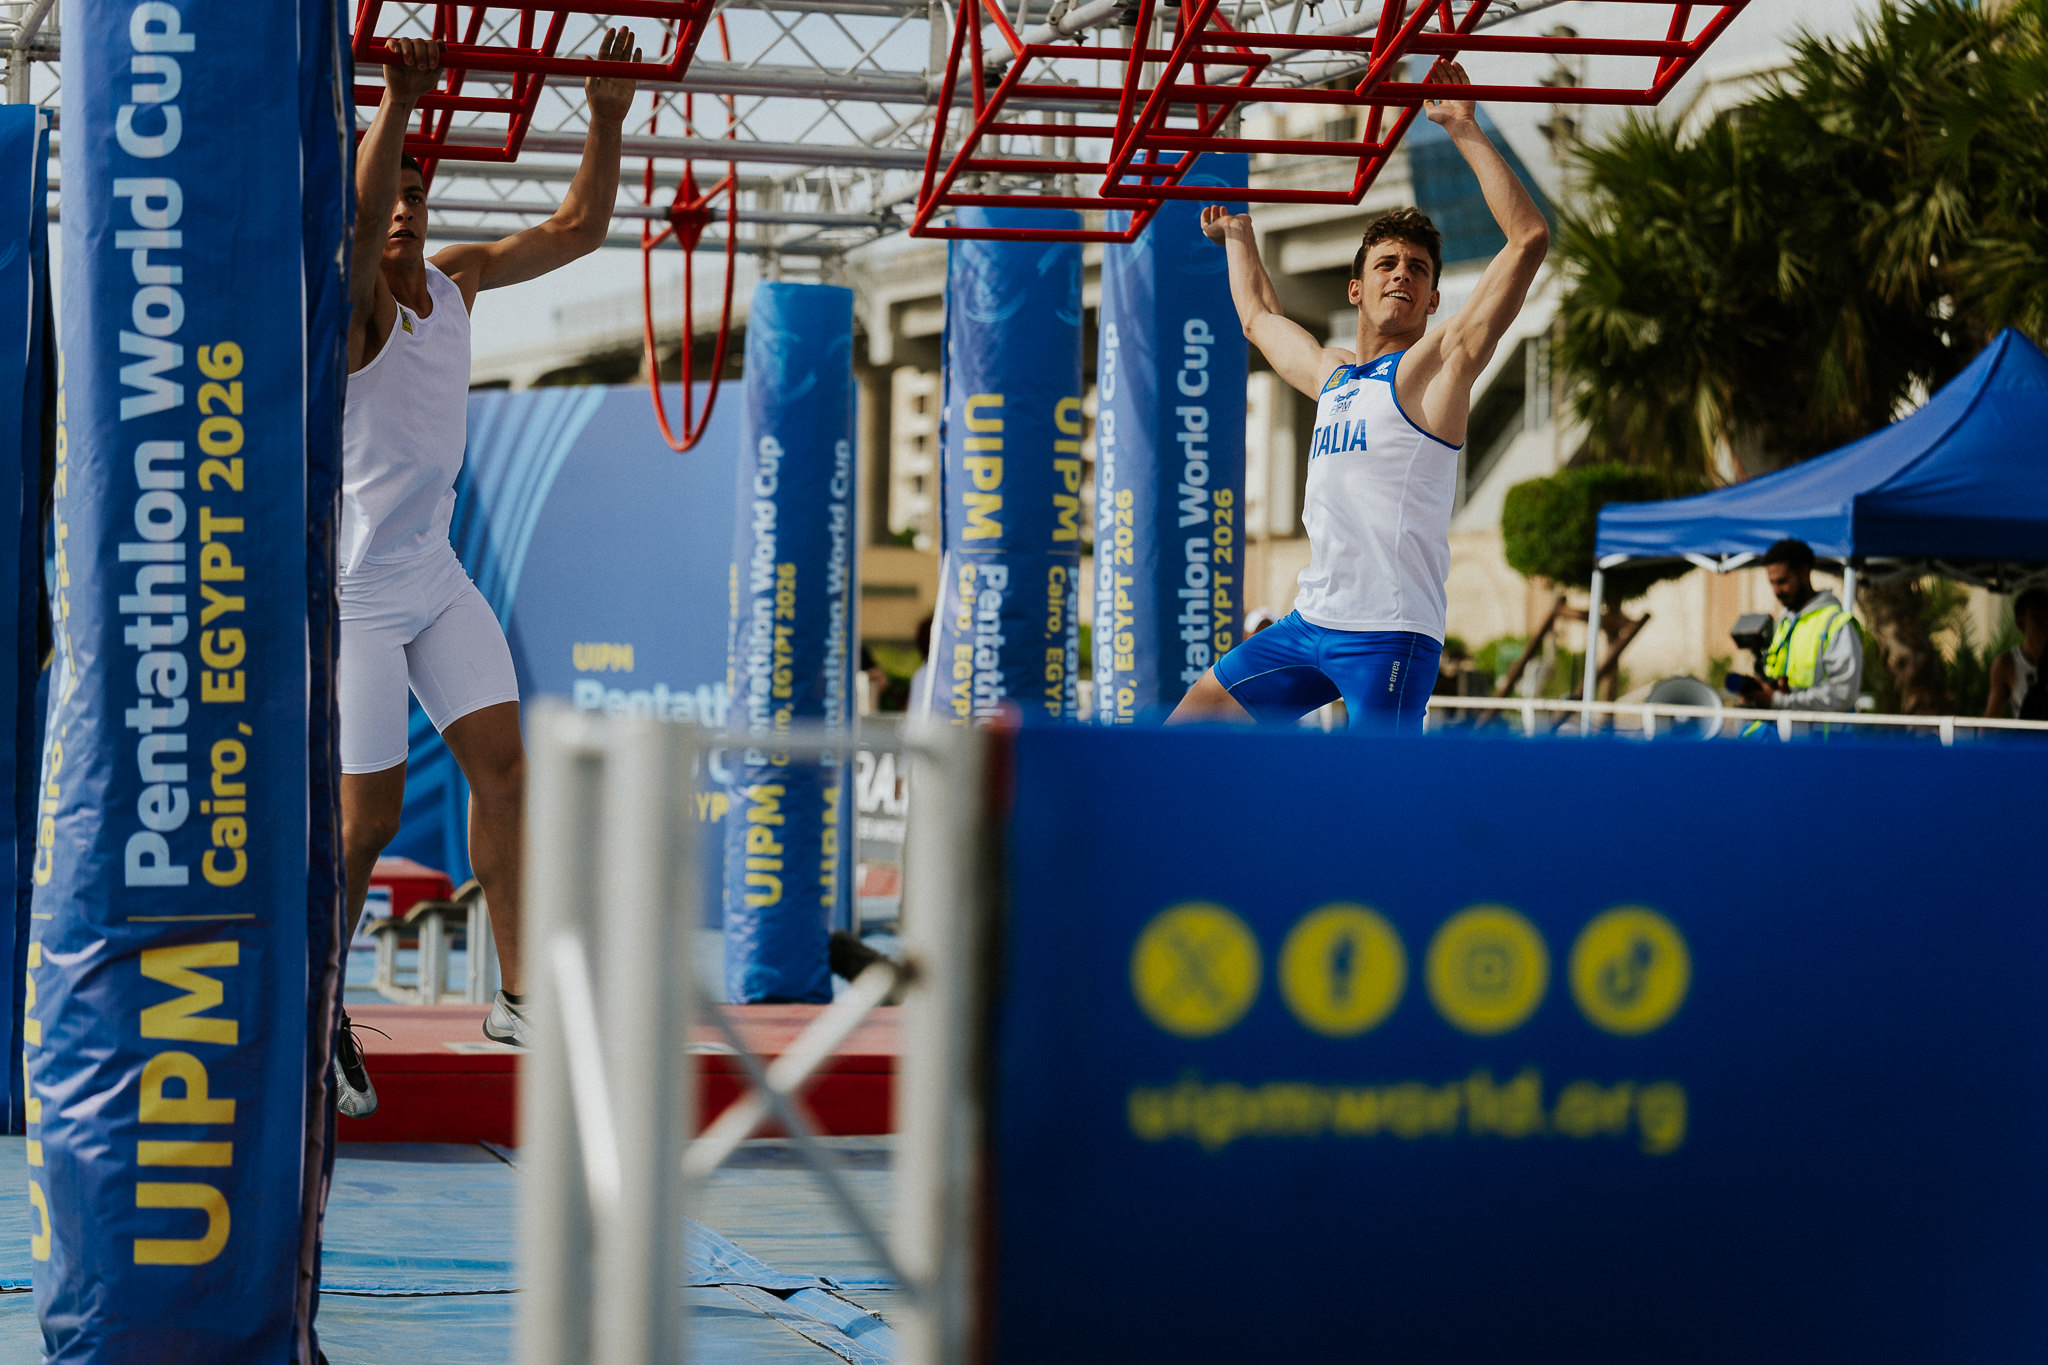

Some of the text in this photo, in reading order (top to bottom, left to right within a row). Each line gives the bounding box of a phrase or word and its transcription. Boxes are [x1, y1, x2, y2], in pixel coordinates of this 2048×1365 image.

[1102, 322, 1119, 401] Cup
[112, 1, 195, 887] Pentathlon World Cup
[962, 393, 1004, 541] UIPM
[1052, 397, 1081, 542] UIPM
[1099, 408, 1115, 531] World
[1308, 419, 1368, 462] TALIA
[1114, 488, 1134, 565] 2026
[1176, 318, 1215, 690] tathlon World Cup
[1213, 488, 1234, 564] 2026
[197, 341, 254, 887] Cairo, EGYPT 2026
[743, 435, 785, 766] Pntathlon World Cup
[772, 624, 794, 698] EGYPT
[953, 563, 977, 638] Cairo,
[1044, 565, 1066, 719] Cairo, EGYP
[1114, 571, 1134, 671] EGYPT
[744, 784, 785, 907] UIPM
[133, 940, 240, 1266] UIPM
